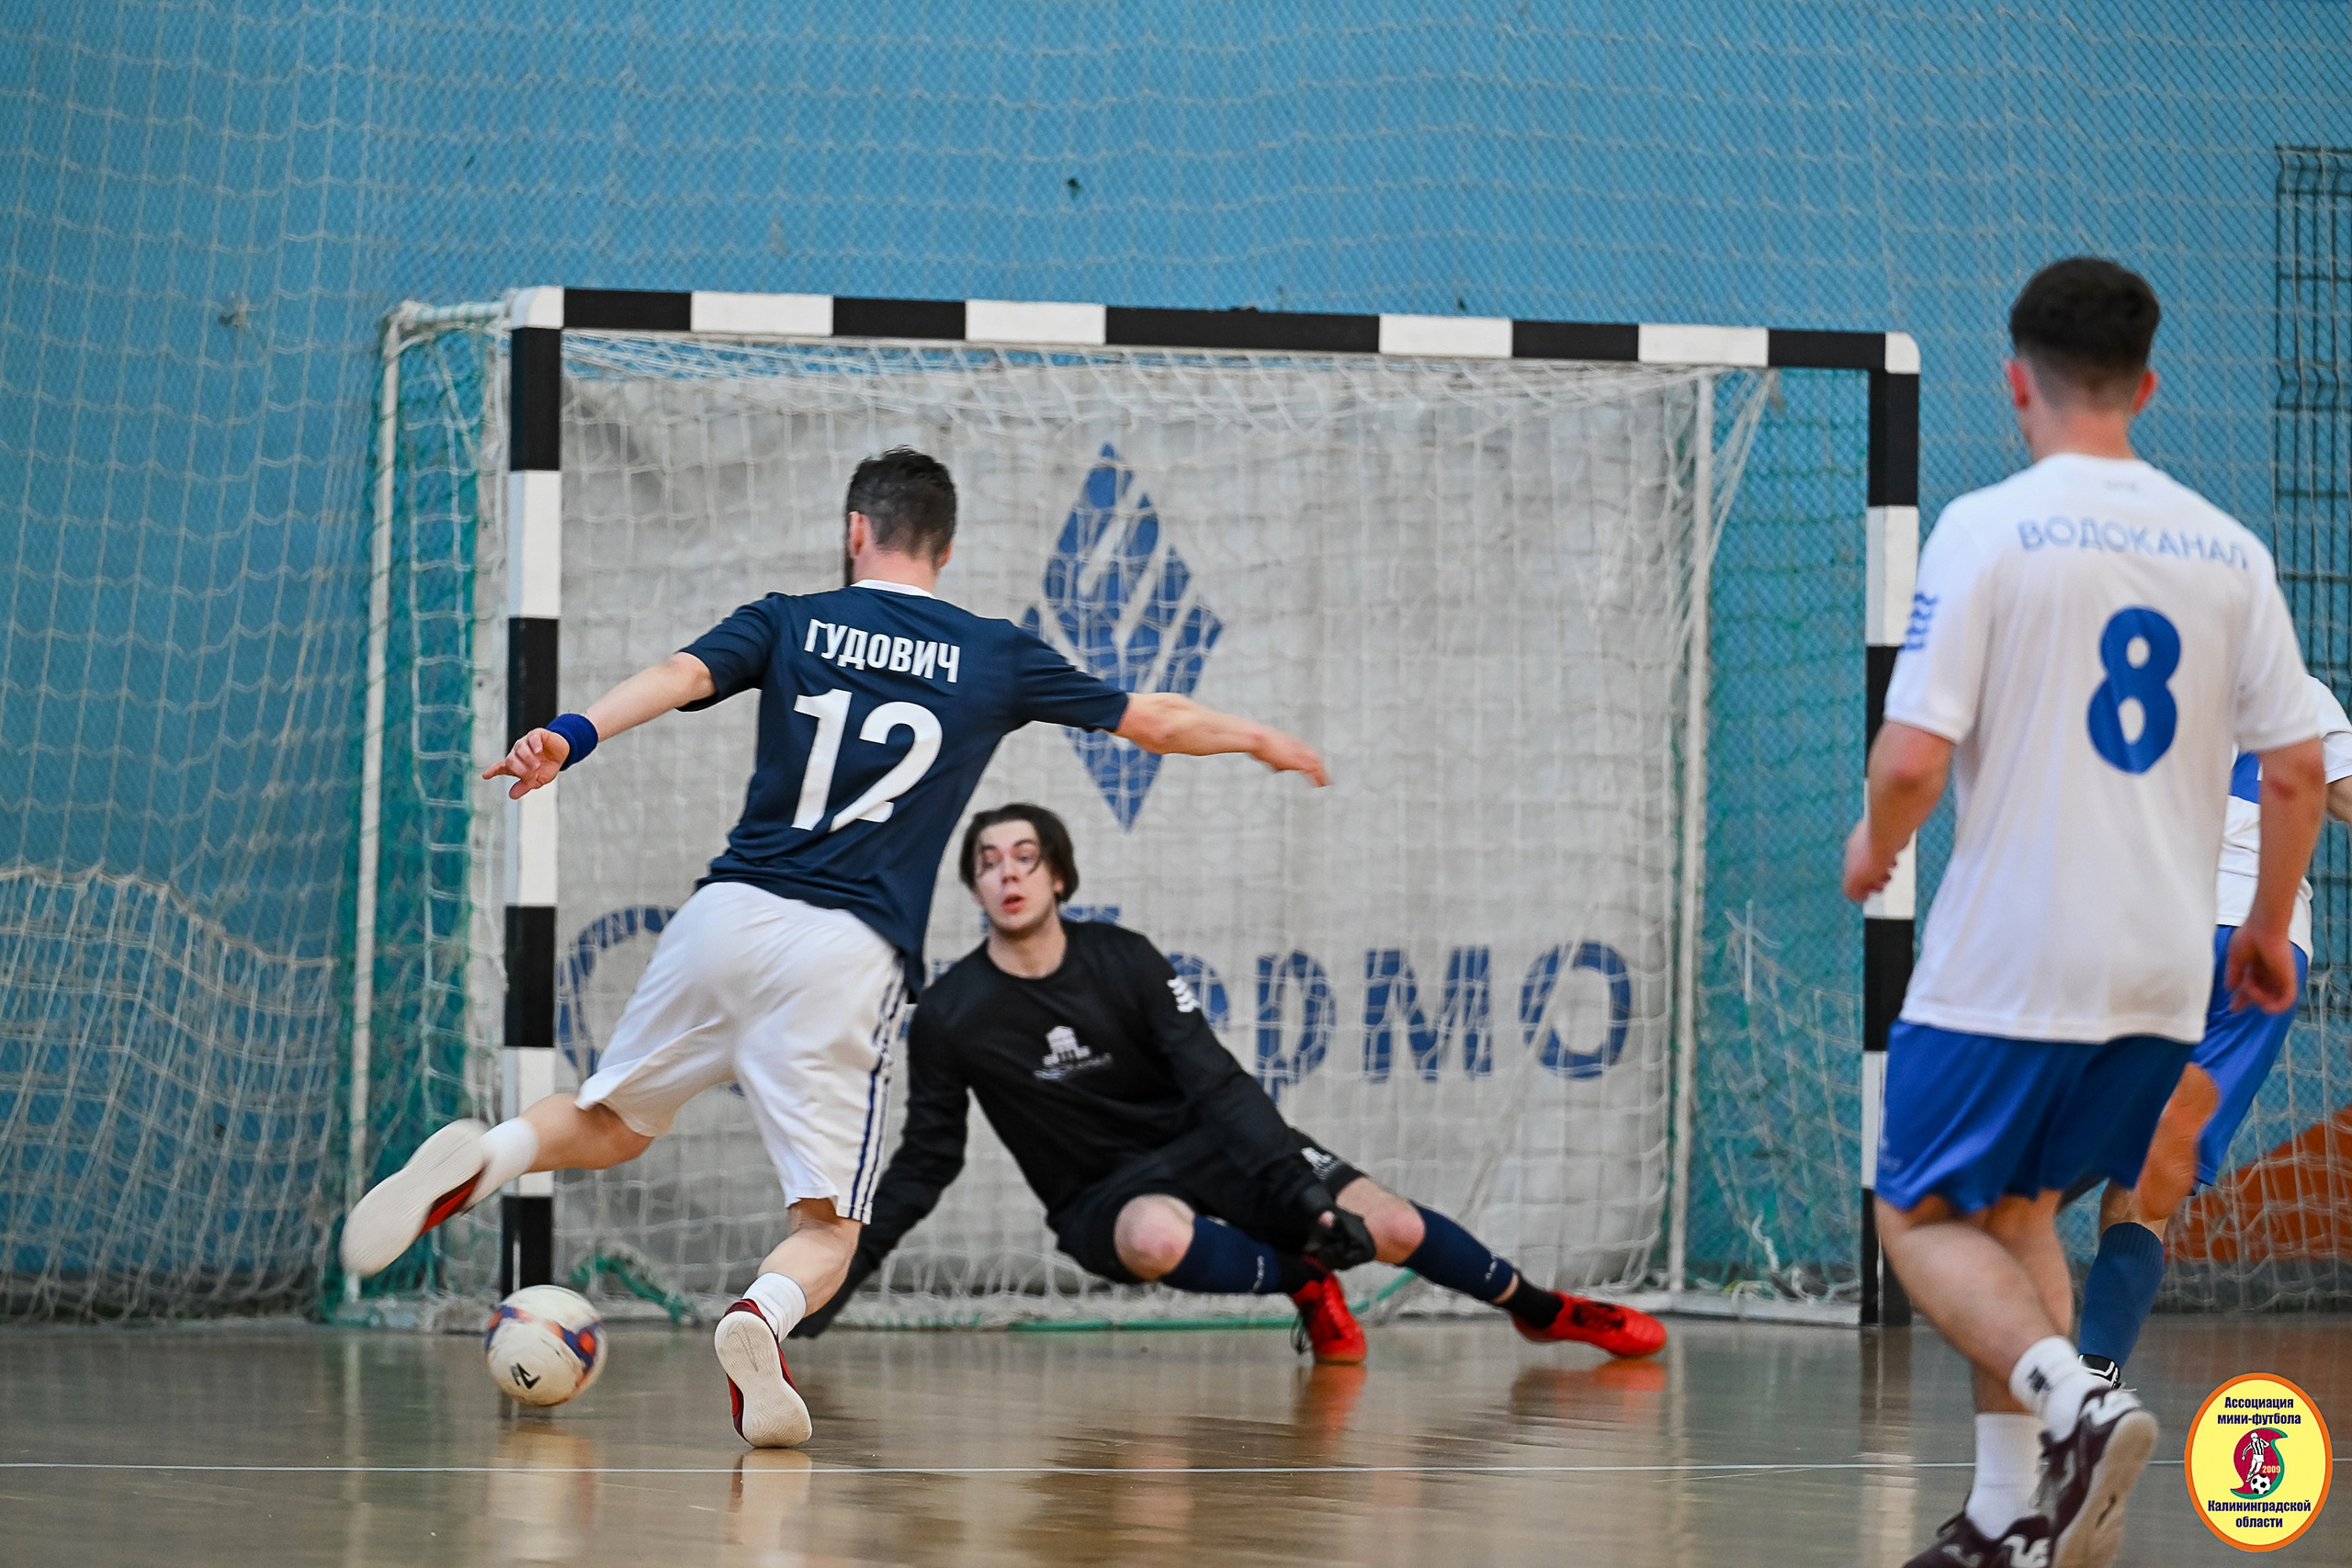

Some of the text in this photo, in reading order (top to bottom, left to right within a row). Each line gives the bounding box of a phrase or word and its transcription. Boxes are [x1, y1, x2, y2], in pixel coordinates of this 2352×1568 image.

[2017, 515, 2250, 570] ВОДОКАНАЛ
[804, 618, 961, 683] ГУДОВИЧ
[2086, 604, 2182, 775] 8
[790, 688, 944, 834] 12
